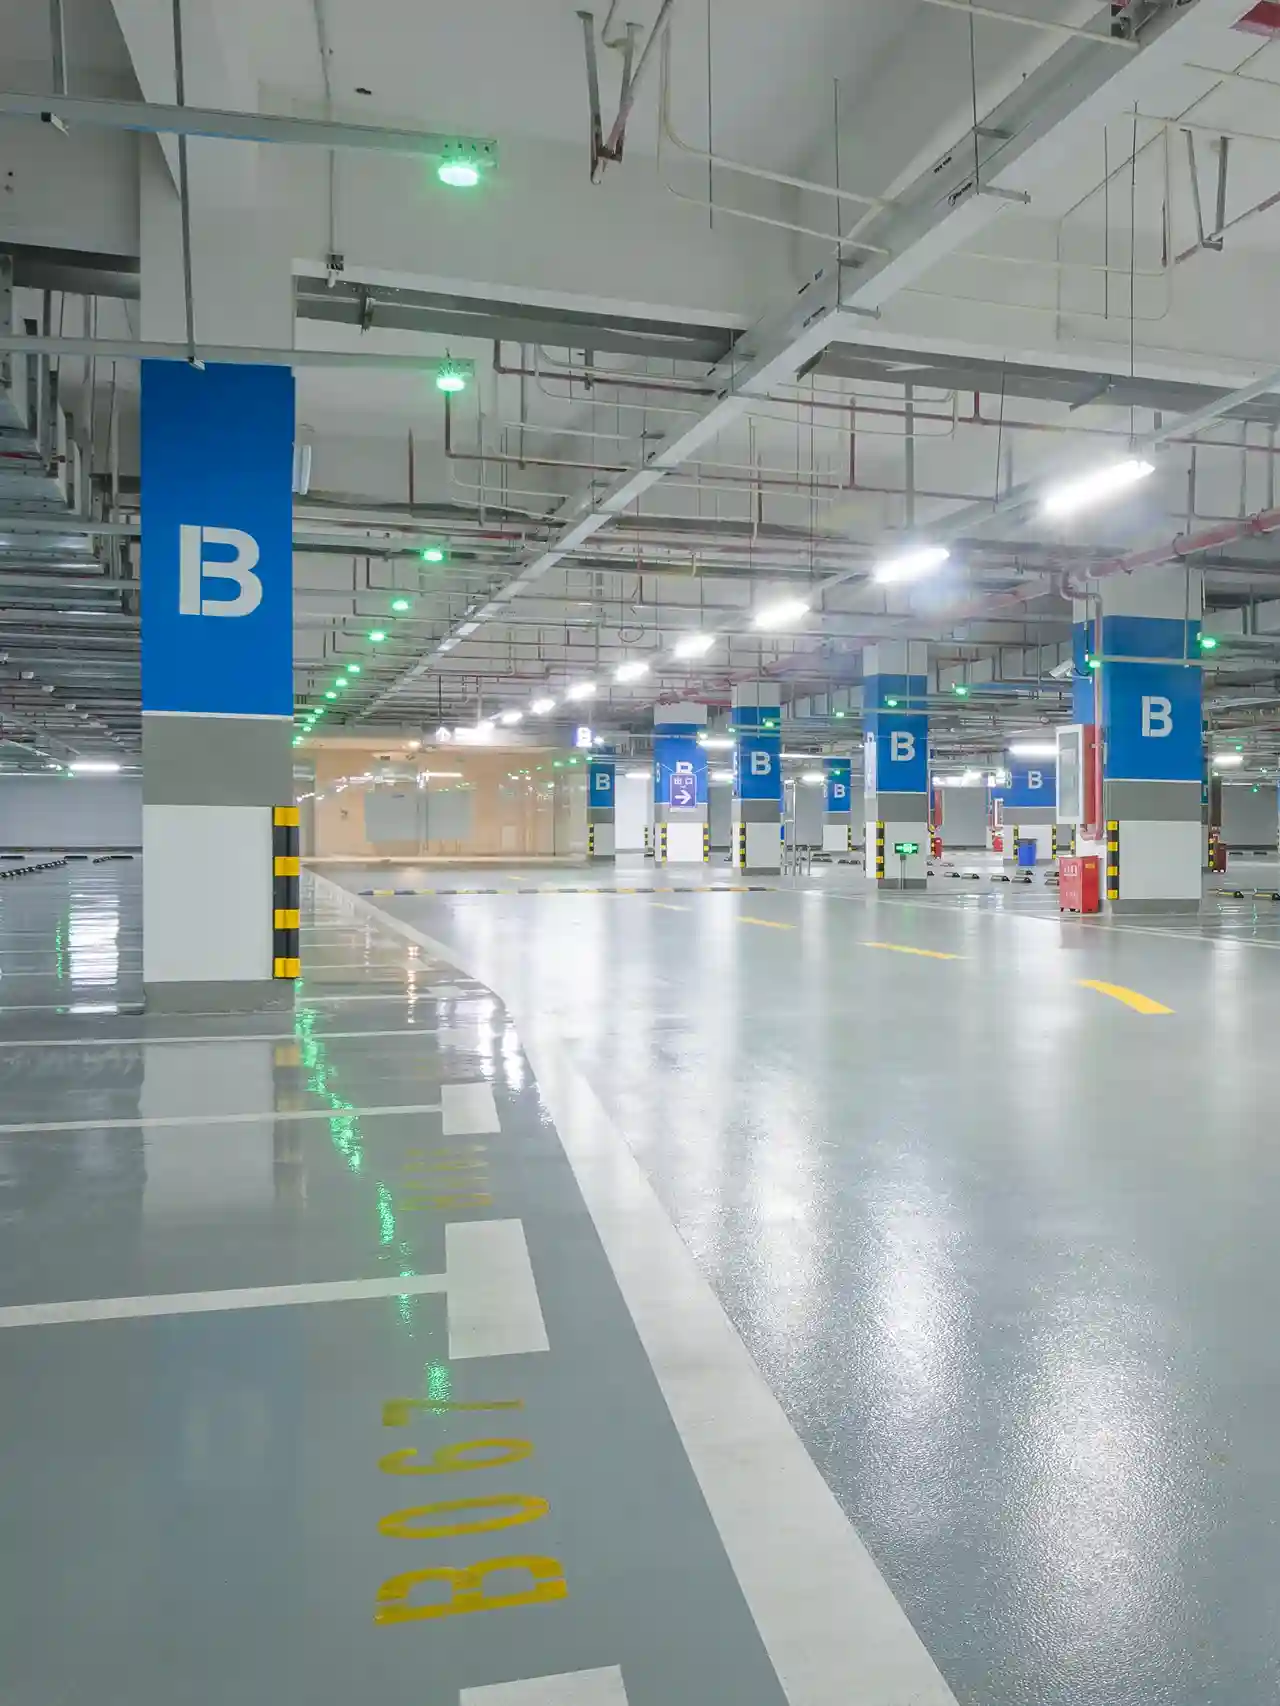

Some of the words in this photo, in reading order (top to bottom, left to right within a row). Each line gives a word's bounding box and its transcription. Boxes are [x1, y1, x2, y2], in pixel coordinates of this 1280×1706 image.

[179, 524, 263, 617] B
[1141, 696, 1173, 738] B
[890, 731, 916, 762] B
[751, 751, 771, 775] B
[596, 773, 610, 791] B
[834, 784, 845, 798] B
[1028, 771, 1043, 789] B
[373, 1398, 569, 1626] B067
